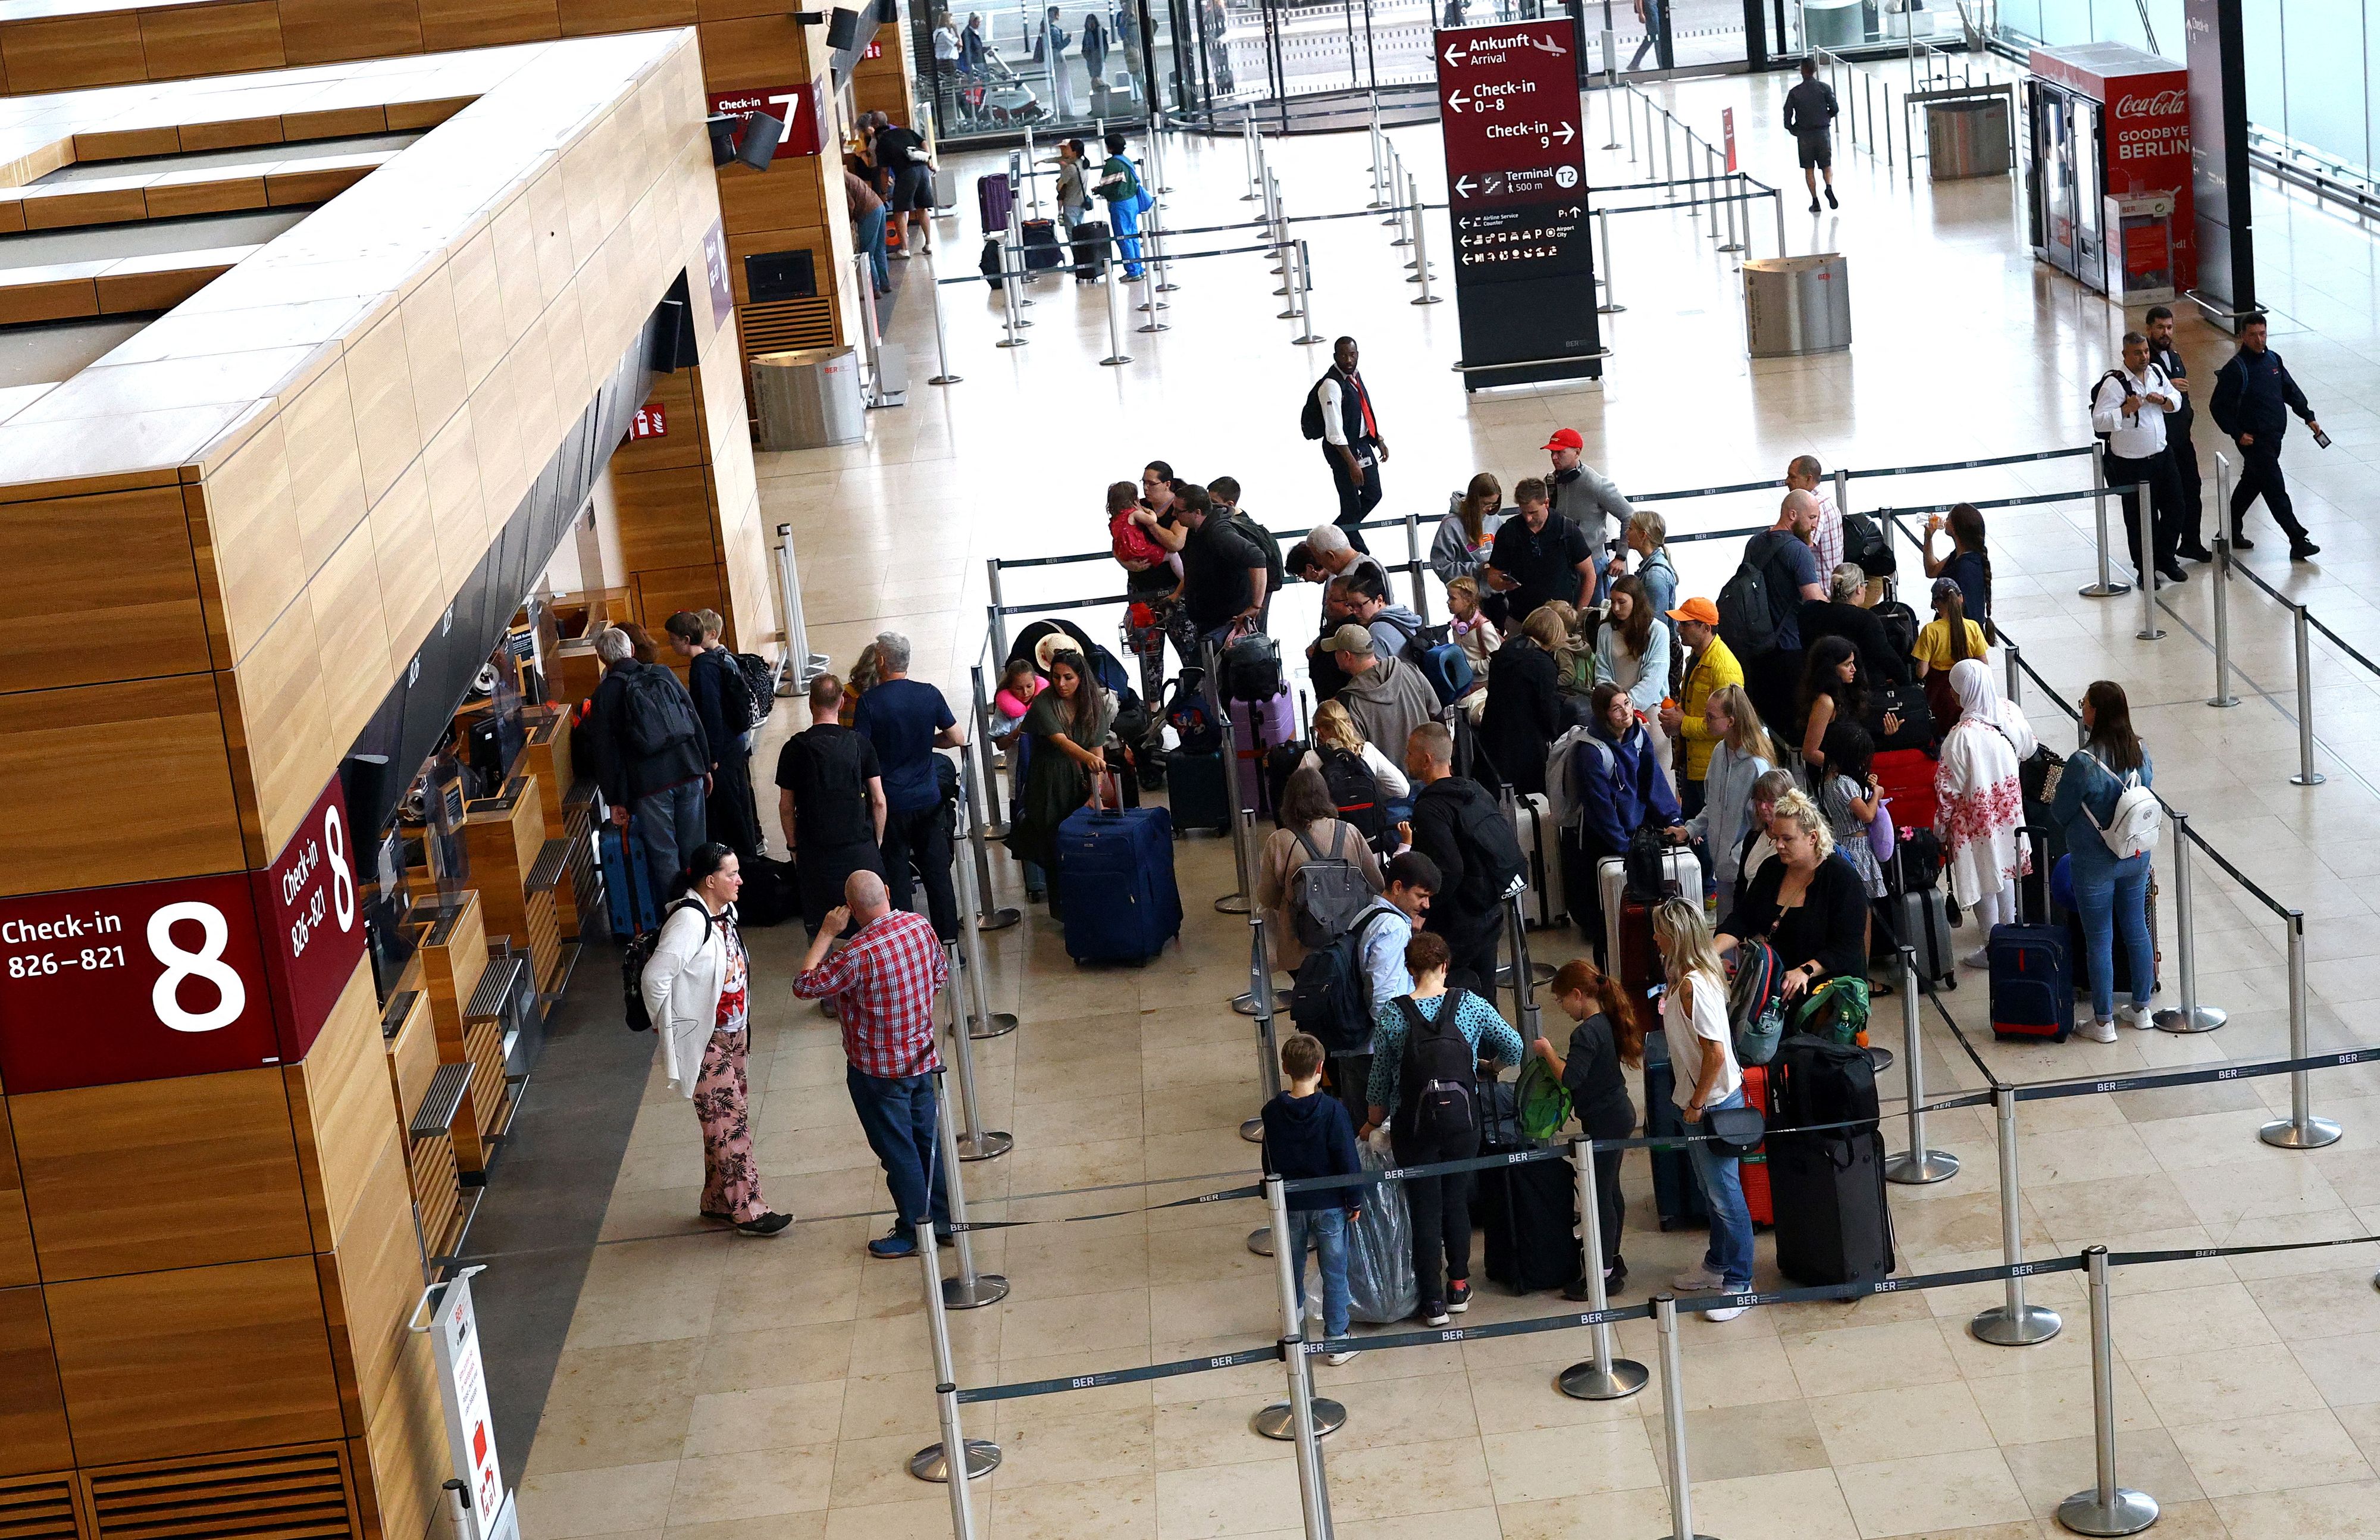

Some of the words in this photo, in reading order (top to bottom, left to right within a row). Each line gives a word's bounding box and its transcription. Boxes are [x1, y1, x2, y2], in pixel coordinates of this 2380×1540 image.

[1470, 34, 1529, 51] Ankunft
[1470, 52, 1506, 65] Arrival
[1474, 80, 1536, 98] Check-in
[2115, 89, 2188, 119] Coca-Cola
[719, 98, 761, 110] Check-in
[769, 93, 798, 143] 7
[1486, 121, 1548, 138] Check-in
[2119, 125, 2189, 142] GOODBYE
[1540, 136, 1549, 148] 9
[2119, 138, 2190, 160] BERLIN
[1505, 167, 1554, 181] Terminal
[1559, 171, 1574, 183] T2
[1516, 183, 1532, 192] 500
[717, 229, 728, 293] 8
[409, 652, 420, 688] 826
[283, 838, 319, 906] Check-in
[324, 805, 354, 933] 8
[1501, 884, 1527, 899] adidas
[291, 885, 327, 957] 826–821
[2, 911, 121, 944] Check-in
[8, 946, 126, 978] 826–821
[147, 901, 246, 1032] 8
[2339, 1053, 2357, 1063] BER
[2218, 1069, 2237, 1079] BER
[2097, 1082, 2116, 1092] BER
[1933, 1101, 1952, 1110] BER
[1508, 1152, 1528, 1163] BER
[1385, 1169, 1404, 1180] BER
[1199, 1194, 1219, 1202] BER
[950, 1223, 970, 1231] BER
[2012, 1264, 2034, 1276] BER
[1874, 1281, 1896, 1292] BER
[1736, 1295, 1758, 1307] BER
[1581, 1313, 1603, 1324] BER
[1442, 1330, 1464, 1341] BER
[1303, 1343, 1324, 1354] BER
[1211, 1356, 1233, 1368] BER
[1072, 1377, 1094, 1388] BER
